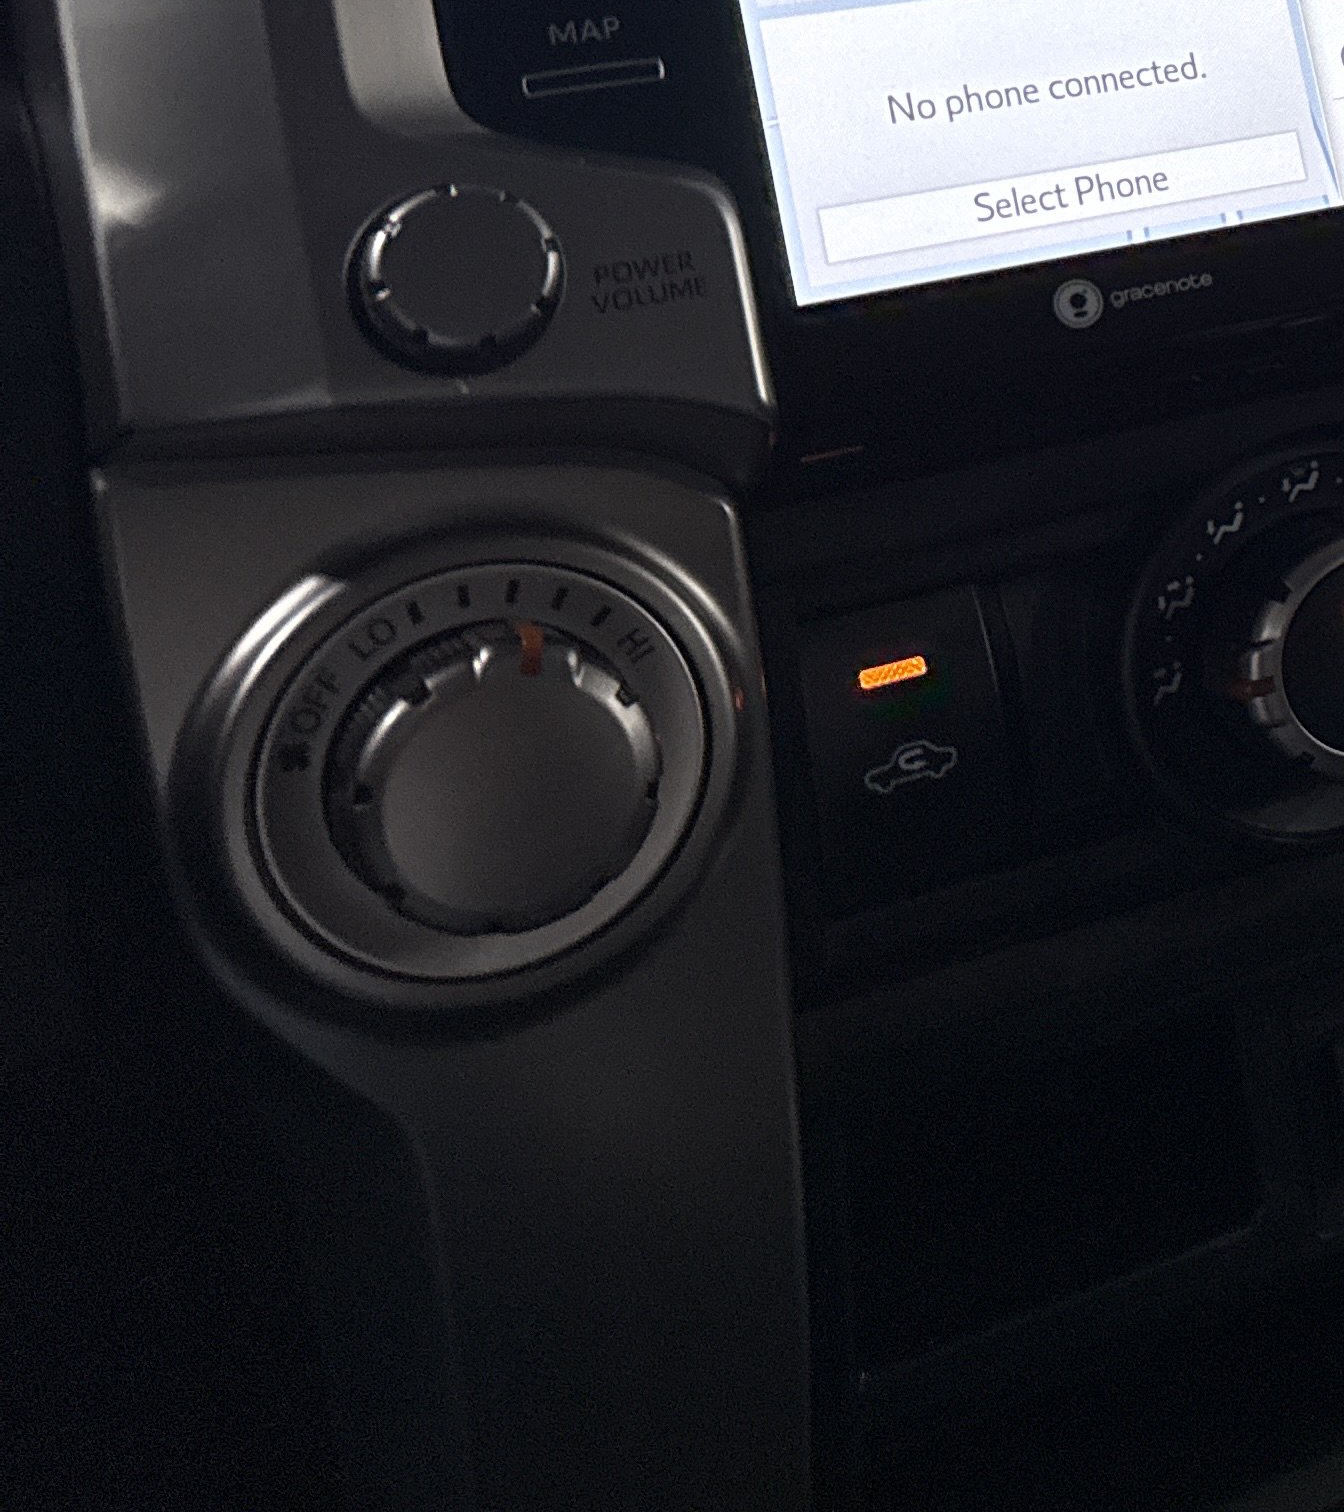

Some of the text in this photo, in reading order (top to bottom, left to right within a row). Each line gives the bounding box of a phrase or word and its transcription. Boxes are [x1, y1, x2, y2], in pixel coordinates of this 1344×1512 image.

[548, 16, 621, 46] MAP
[886, 52, 1208, 124] No phone connected.
[973, 168, 1170, 223] Select Phone
[593, 250, 696, 284] POWER
[592, 277, 704, 314] VOLUME
[1109, 271, 1214, 309] gracenote
[348, 617, 396, 662] LO
[616, 627, 655, 665] HI
[290, 671, 338, 734] OFF
